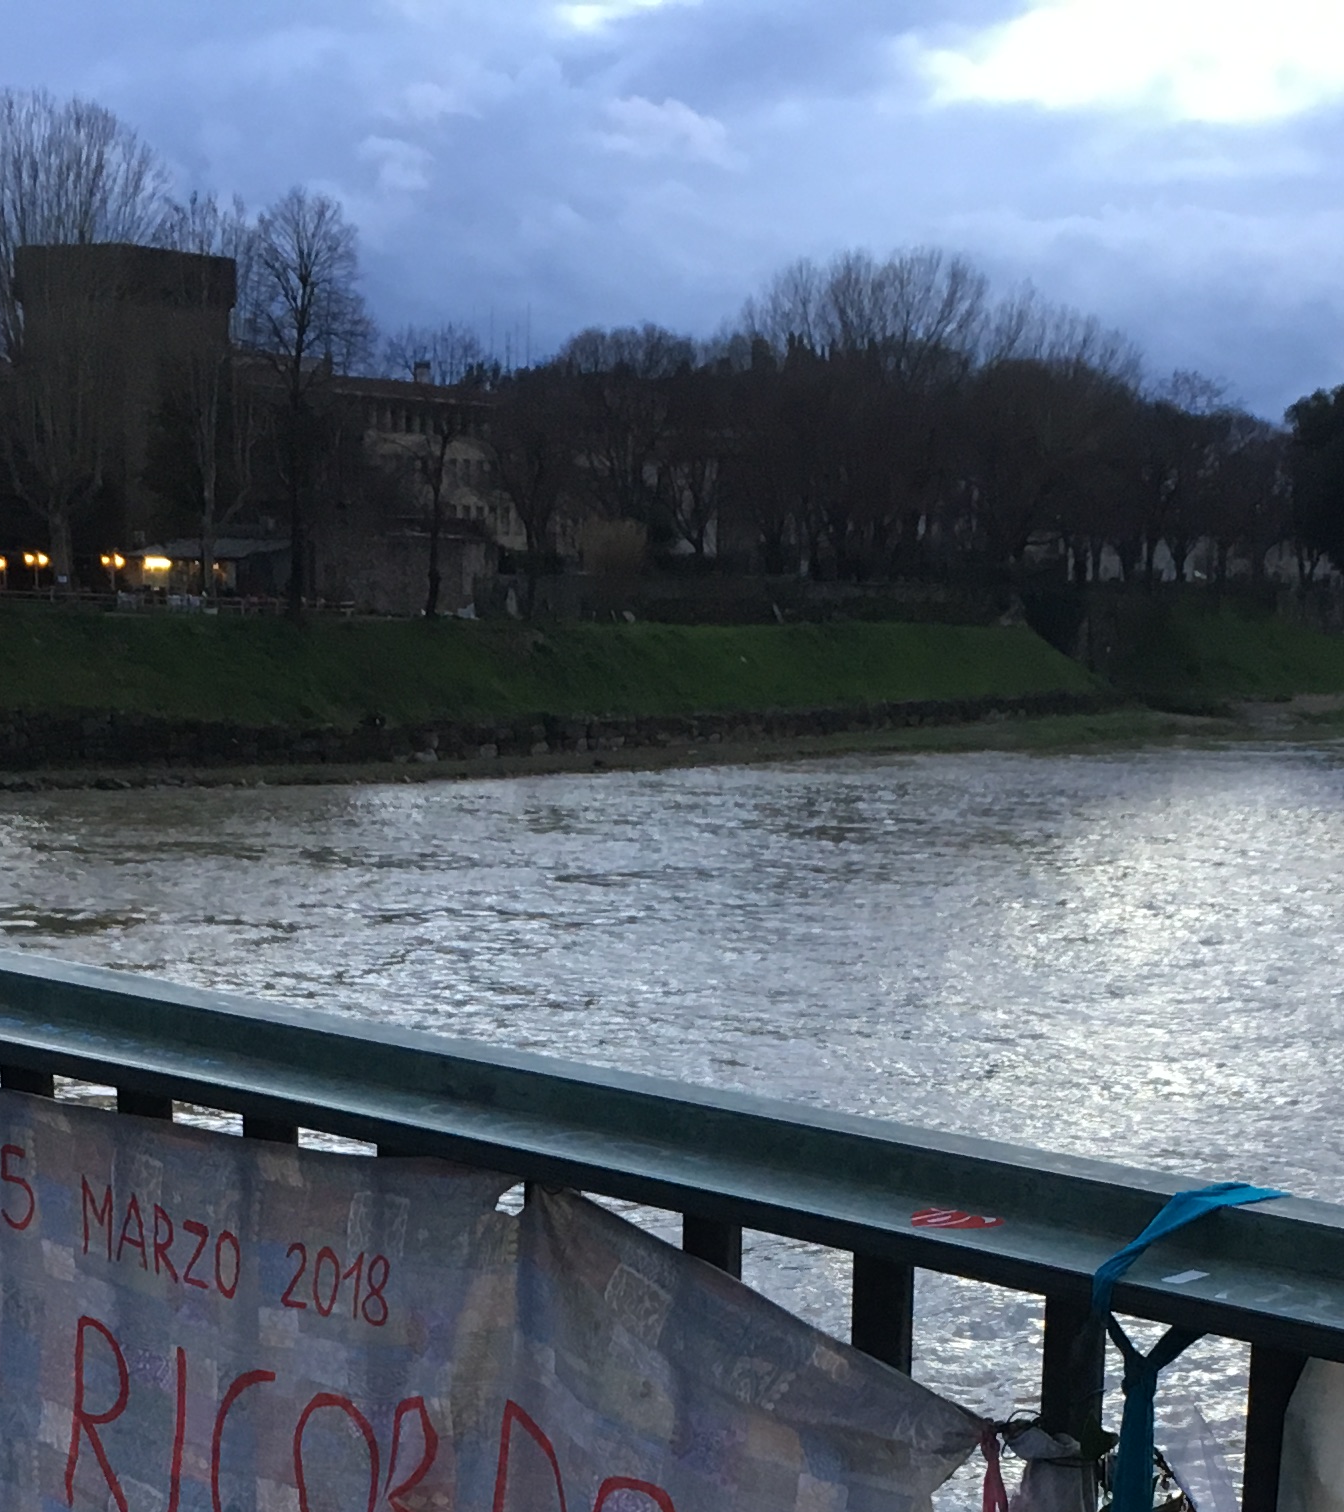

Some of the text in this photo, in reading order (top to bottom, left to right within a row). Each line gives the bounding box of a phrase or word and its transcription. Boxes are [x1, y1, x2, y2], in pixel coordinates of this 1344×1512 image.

[0, 1144, 391, 1327] 5 MARZO 2018
